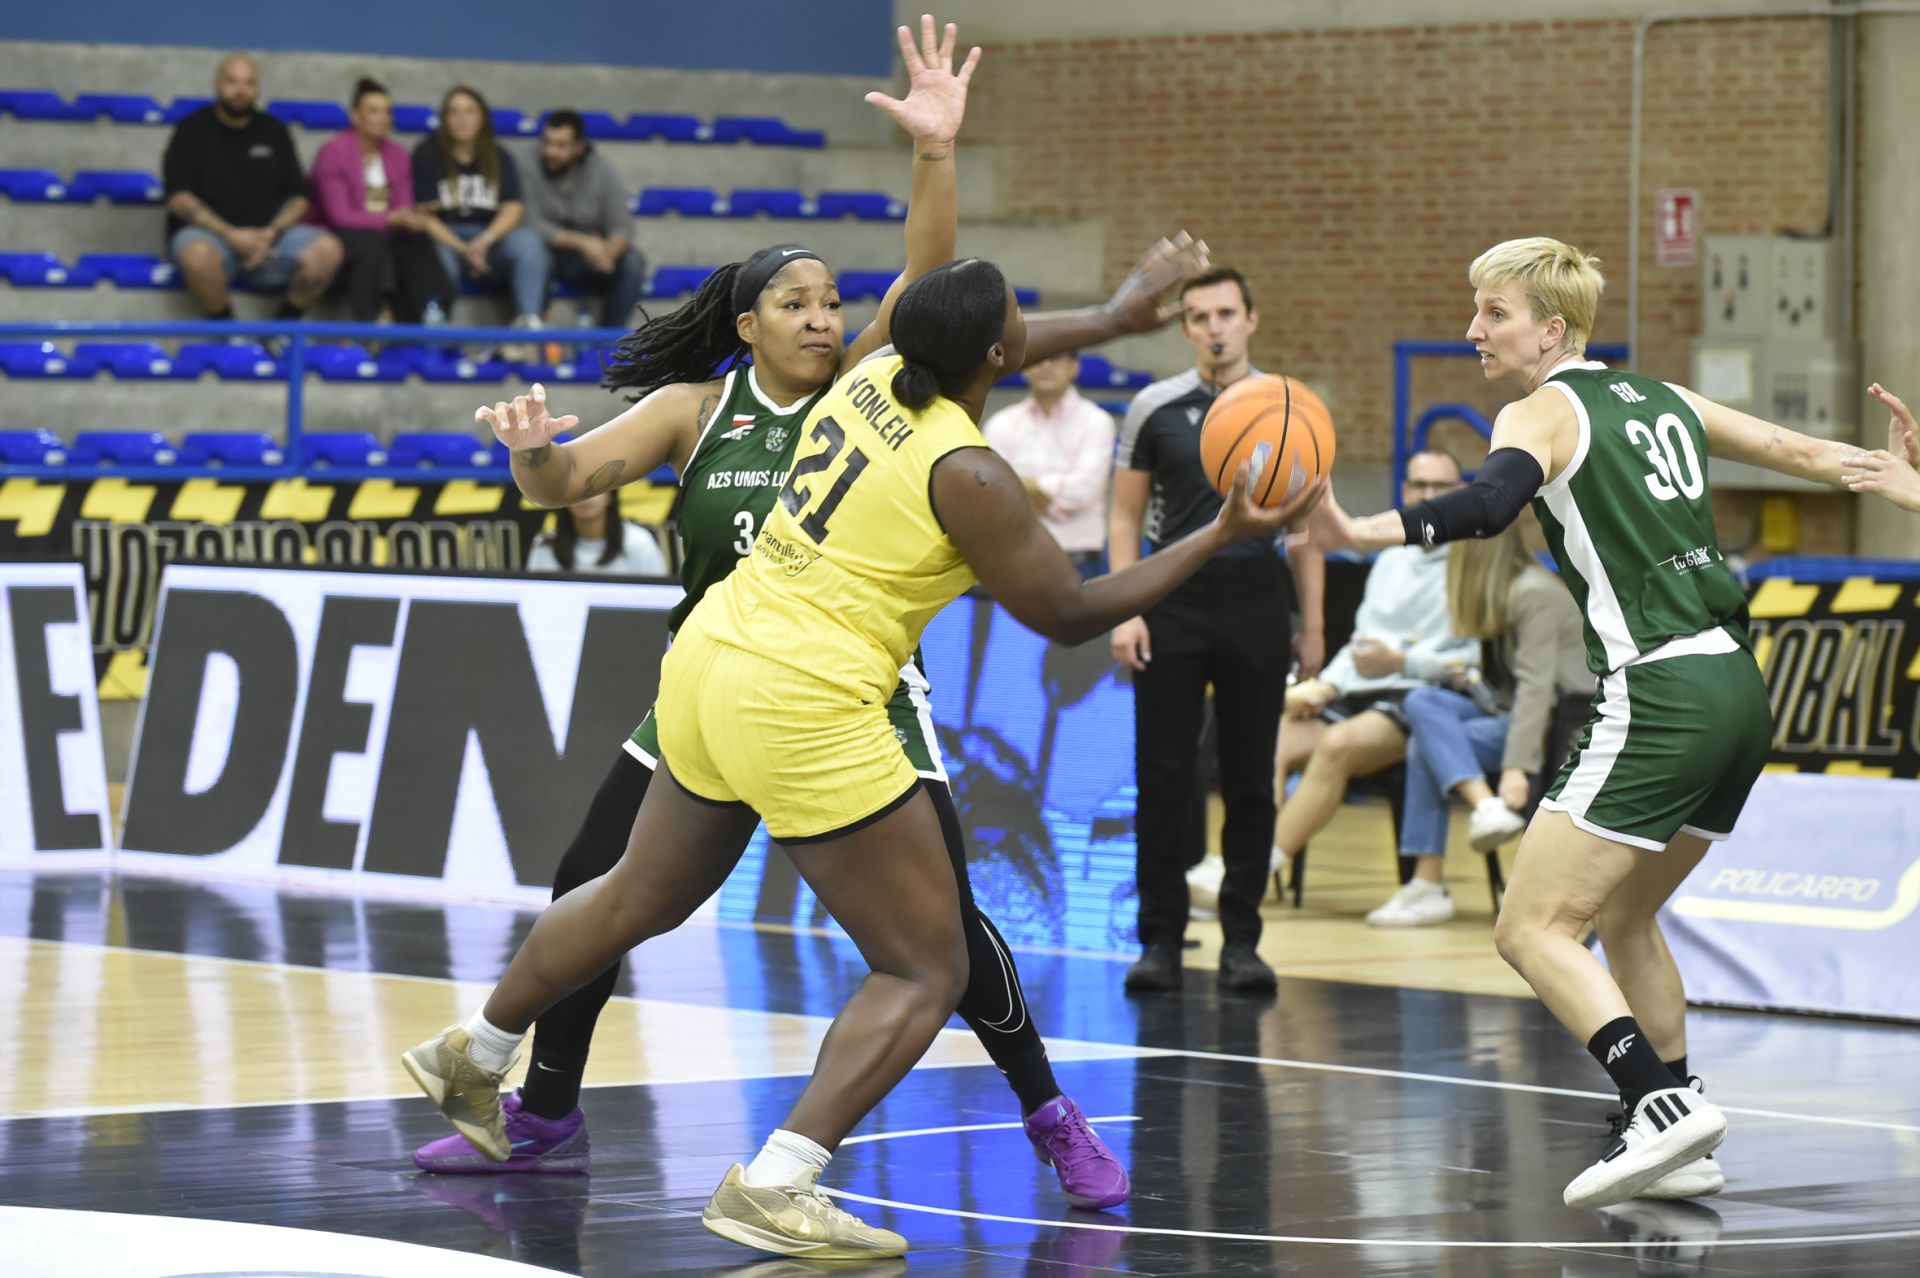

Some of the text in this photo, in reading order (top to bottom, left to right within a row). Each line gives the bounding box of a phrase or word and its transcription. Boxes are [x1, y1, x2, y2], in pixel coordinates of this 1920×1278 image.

[845, 377, 914, 451] VONLEH
[706, 473, 733, 490] AZS
[779, 415, 870, 546] 21
[1624, 412, 1704, 501] 30
[1708, 867, 1881, 903] POLICARPO
